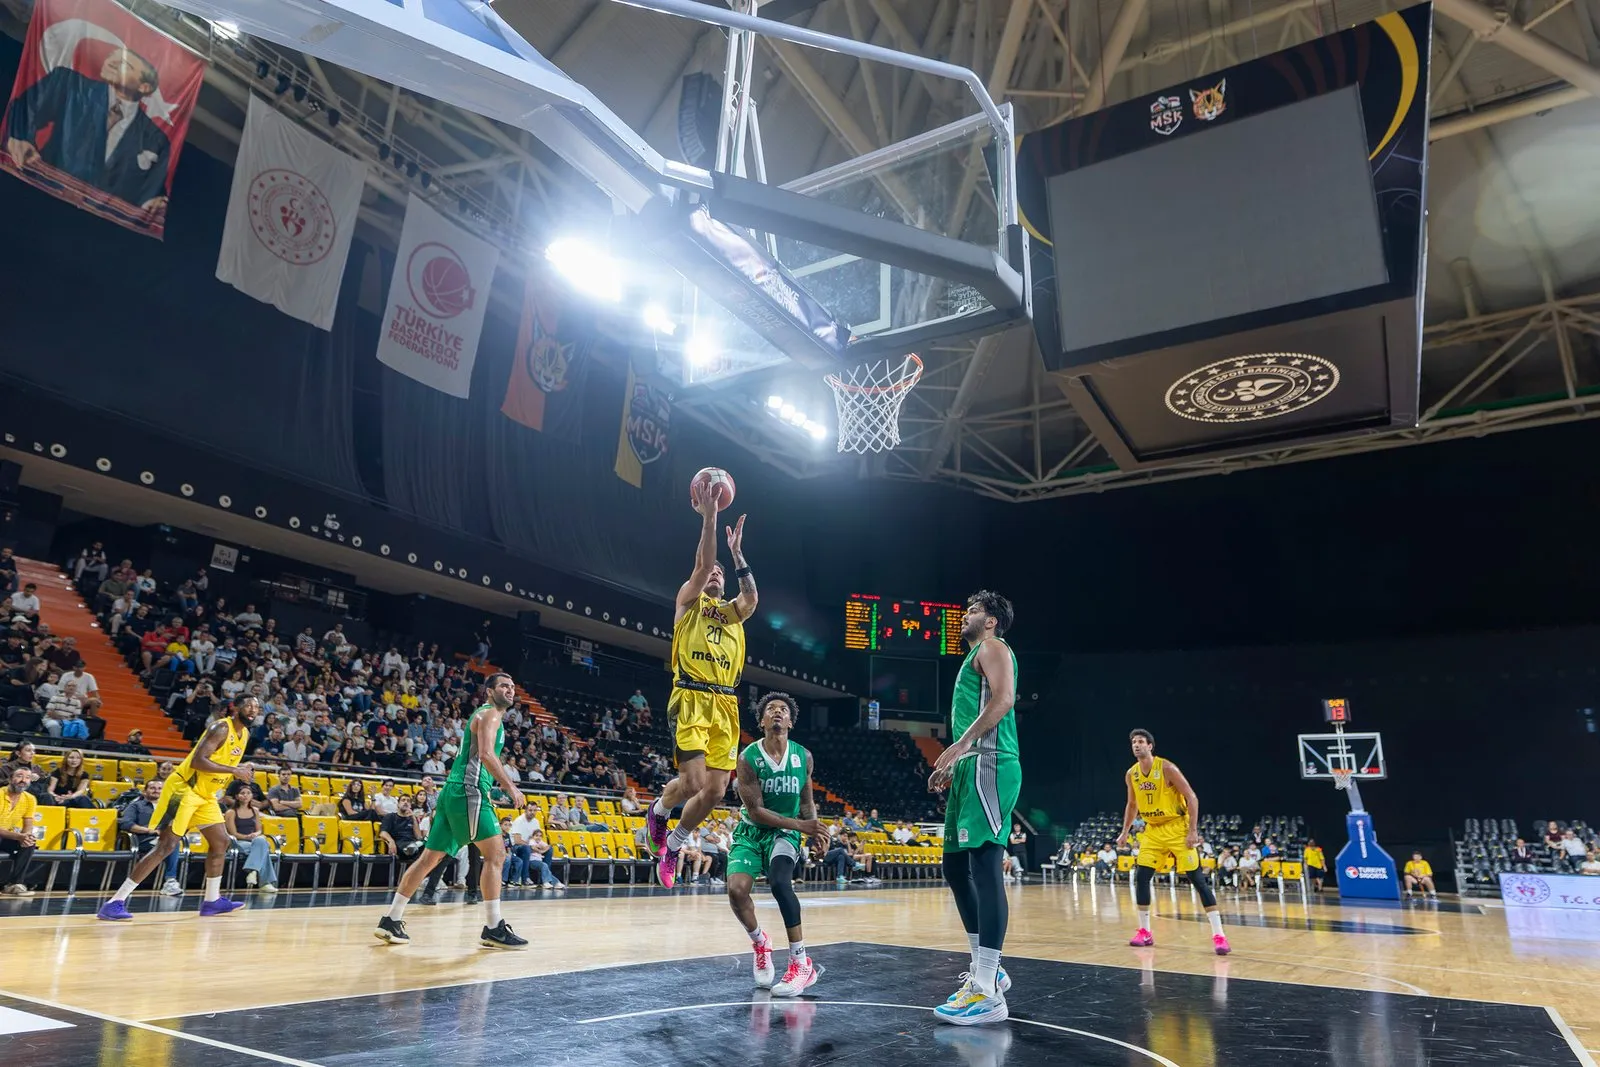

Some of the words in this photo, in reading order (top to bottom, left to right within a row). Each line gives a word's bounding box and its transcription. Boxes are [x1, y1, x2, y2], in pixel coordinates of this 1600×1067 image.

[1150, 110, 1183, 130] MSK
[395, 304, 464, 352] TÜRKİYE
[391, 320, 459, 363] BASKETBOL
[388, 330, 459, 371] FEDERASYONU
[626, 415, 667, 453] MSK
[893, 603, 900, 613] 9
[923, 606, 930, 616] 6
[706, 625, 722, 645] 20
[886, 627, 893, 637] 2
[924, 631, 930, 640] 2
[691, 650, 731, 670] mein
[1332, 707, 1345, 720] 13
[1139, 781, 1158, 791] MSK
[1560, 895, 1589, 905] T.C.
